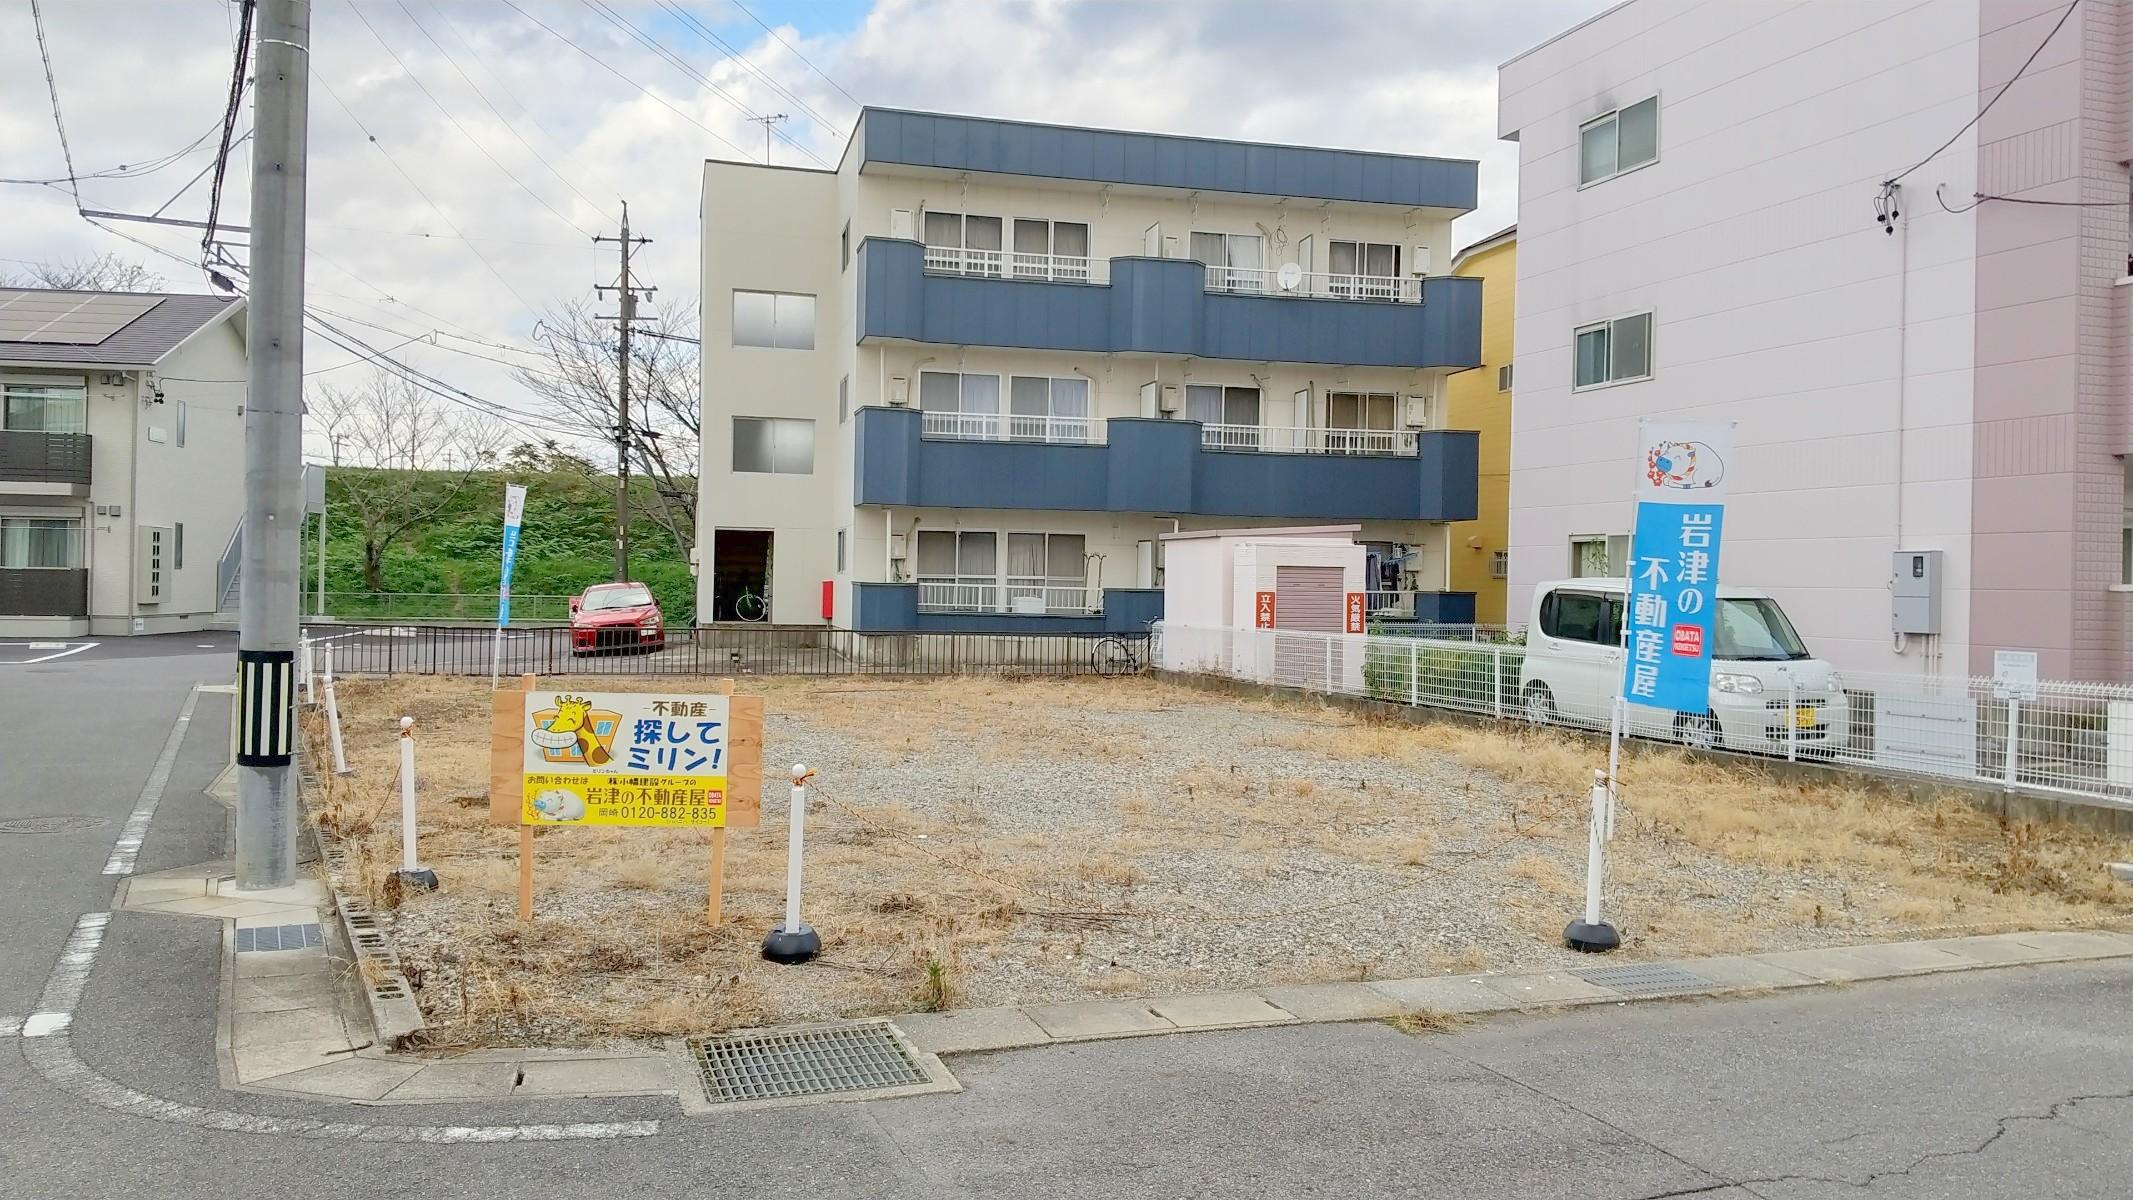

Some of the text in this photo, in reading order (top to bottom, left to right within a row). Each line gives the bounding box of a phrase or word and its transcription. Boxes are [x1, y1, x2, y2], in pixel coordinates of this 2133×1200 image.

[1676, 513, 1712, 615] 岩津の
[1260, 594, 1271, 629] 立入禁止
[1350, 595, 1361, 631] 火気厳禁
[1631, 556, 1670, 698] 不動産屋
[1675, 629, 1700, 643] OBATA
[652, 701, 708, 717] 不動産
[634, 719, 721, 744] 探して
[627, 747, 722, 771] ミリン!
[527, 775, 589, 785] お問い合わせは
[585, 787, 706, 807] 岩津の不動産屋
[598, 806, 717, 820] 岡崎 0120-882-835
